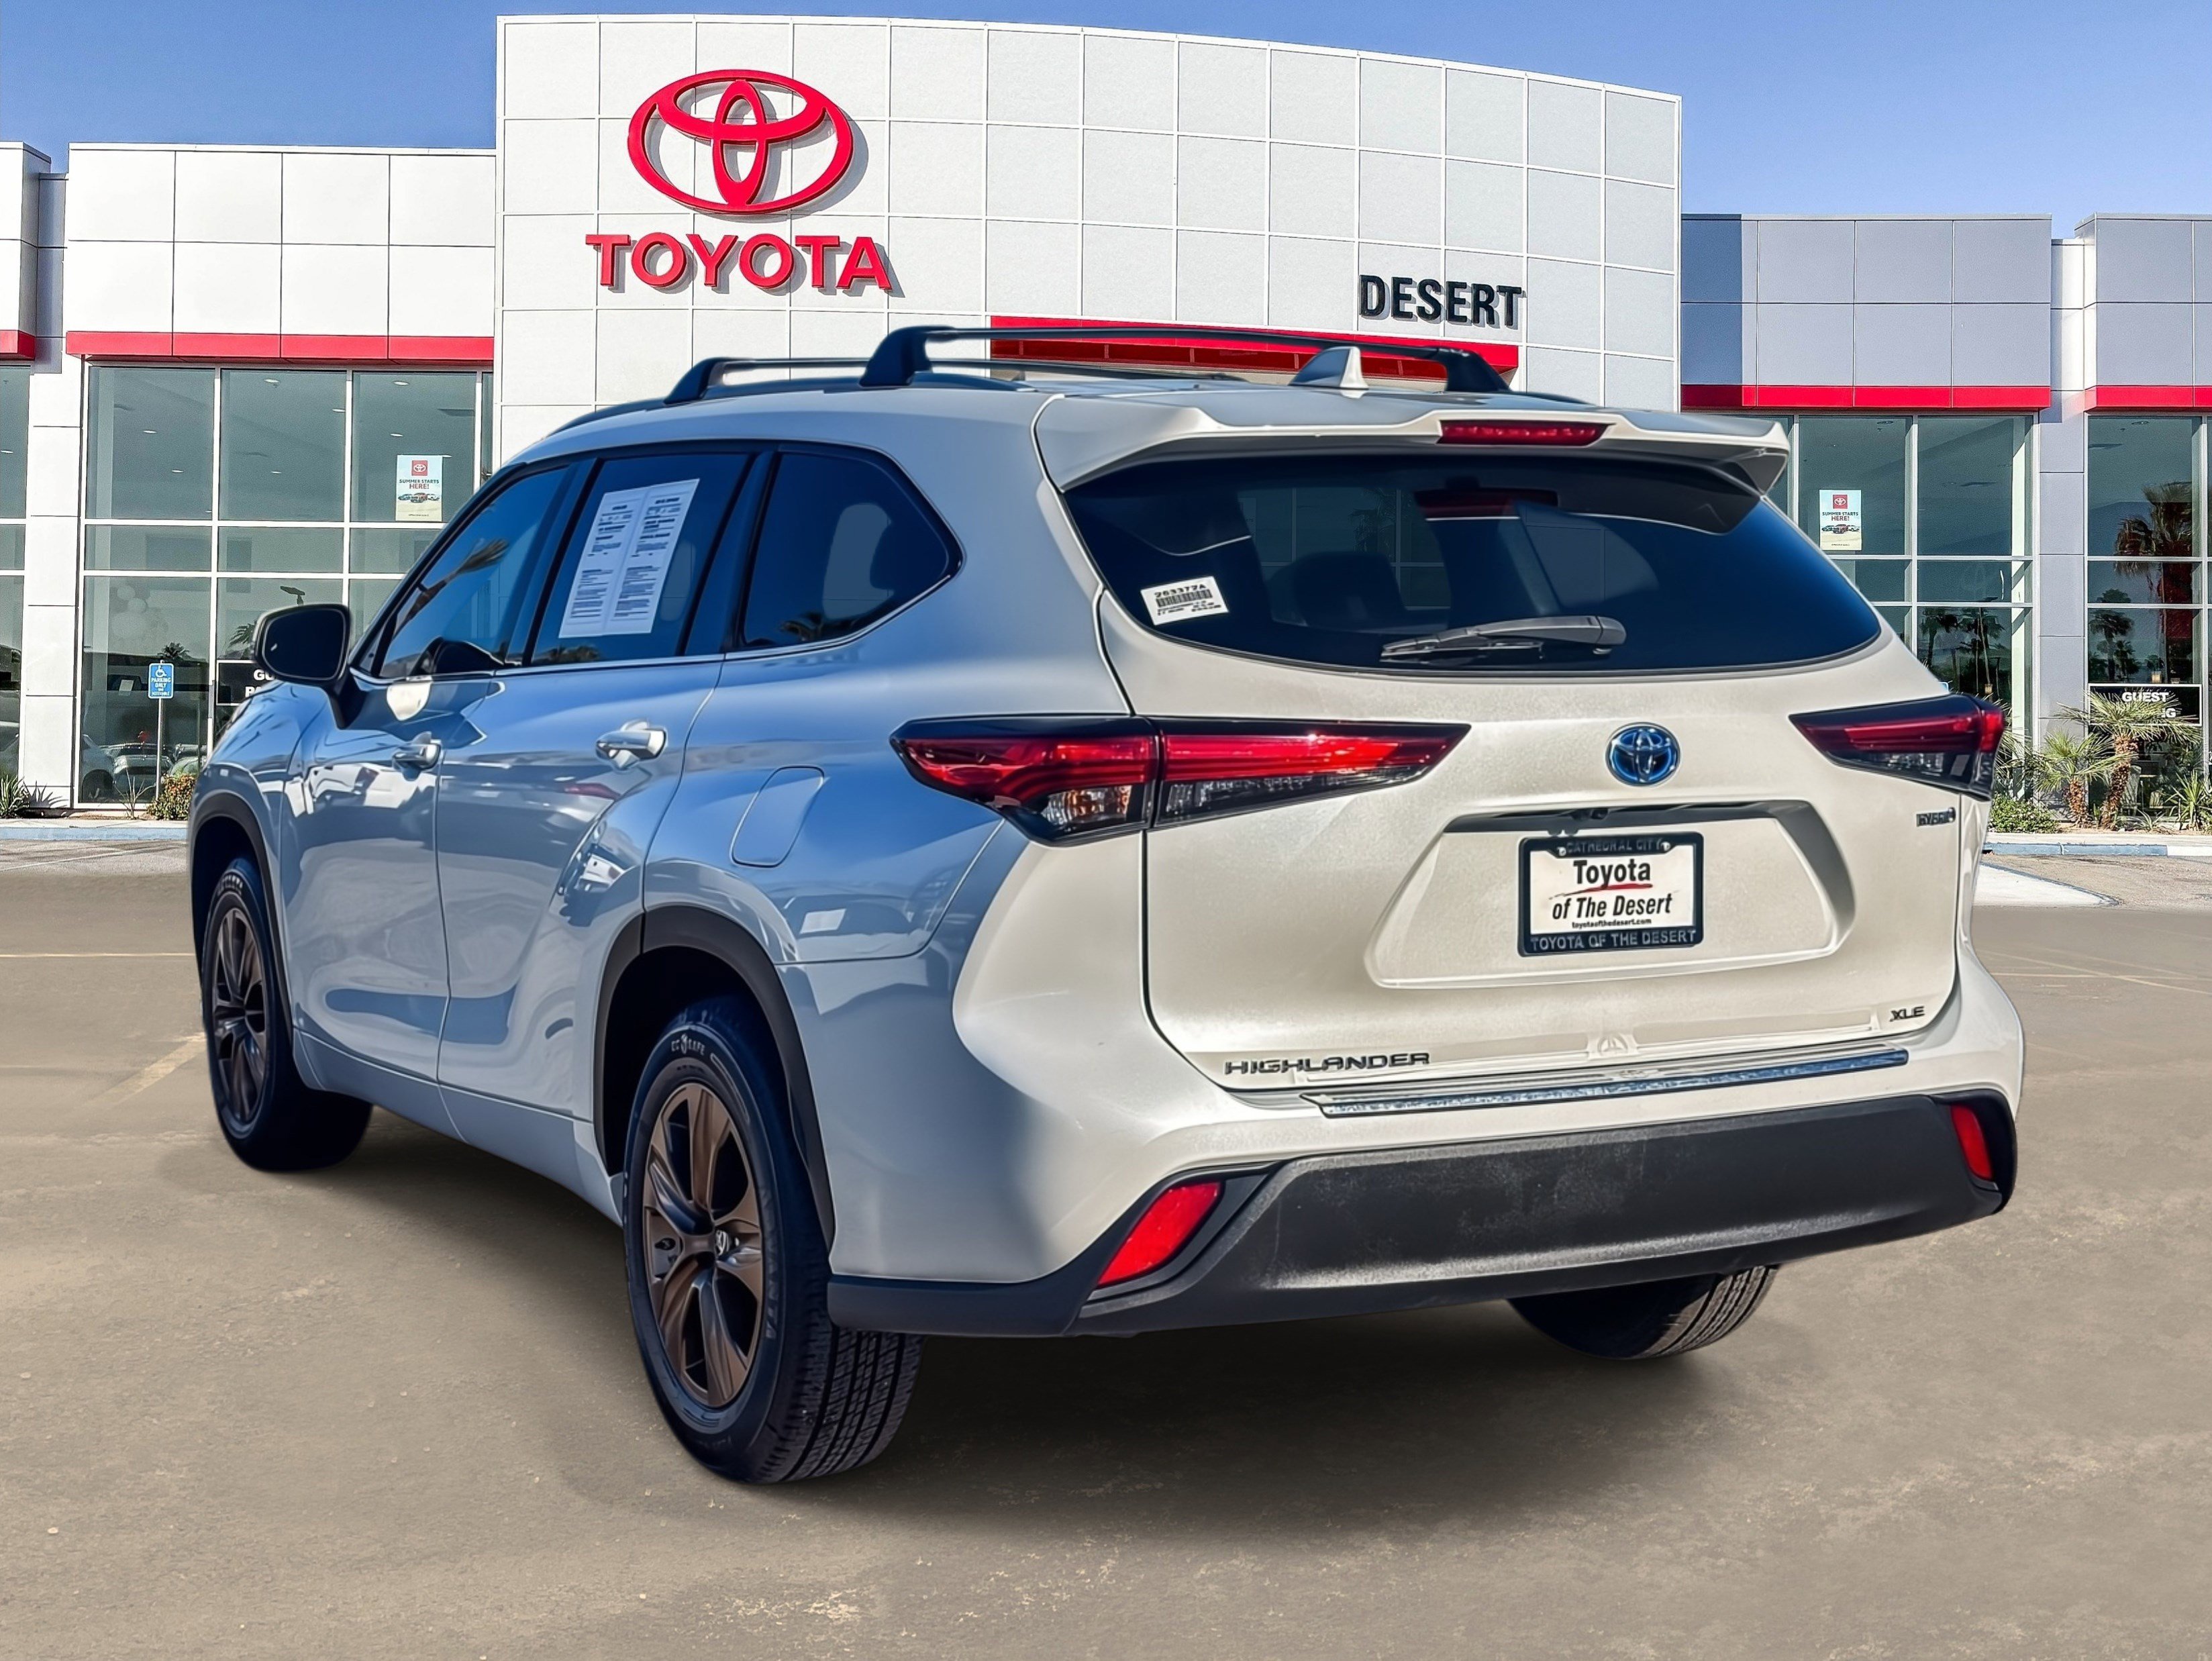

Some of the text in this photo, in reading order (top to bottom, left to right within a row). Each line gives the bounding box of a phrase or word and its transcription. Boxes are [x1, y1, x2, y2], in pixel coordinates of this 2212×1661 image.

[585, 232, 893, 290] TOYOTA
[1359, 274, 1522, 326] DESERT
[2121, 691, 2169, 703] GUEST
[1566, 840, 1633, 854] CATHEDRAL
[1573, 858, 1651, 889] Toyota
[1552, 893, 1672, 919] of The Desert
[1572, 918, 1652, 929] toyotaofthedesert.com
[1531, 930, 1696, 952] TOYOTA OF THE DESERT
[1889, 1005, 1925, 1022] XLE
[1225, 1052, 1429, 1074] HIGHLANDER
